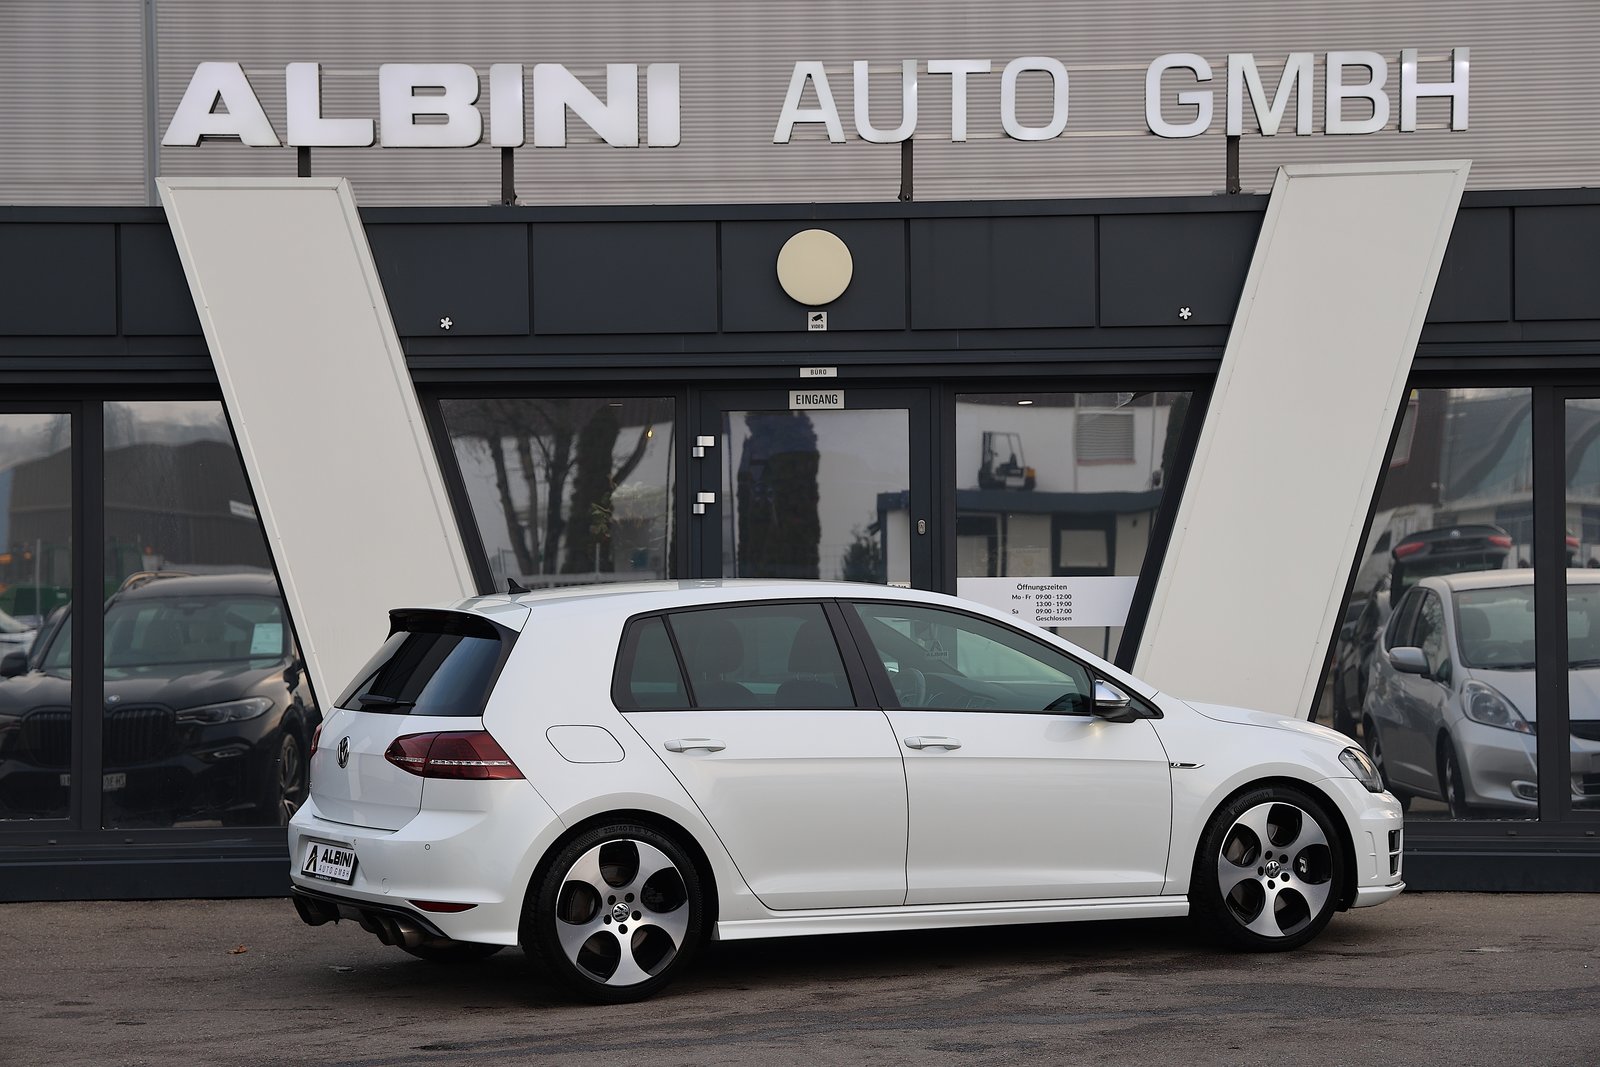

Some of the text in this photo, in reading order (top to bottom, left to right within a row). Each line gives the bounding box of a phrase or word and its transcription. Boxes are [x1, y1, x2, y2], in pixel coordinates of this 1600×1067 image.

[161, 46, 1471, 148] ALBINI AUTO GMBH
[795, 394, 838, 405] EINGANG
[1016, 583, 1068, 591] Öffnungszeiten
[320, 848, 354, 868] ALBINI
[318, 864, 350, 878] AUTO GMBH
